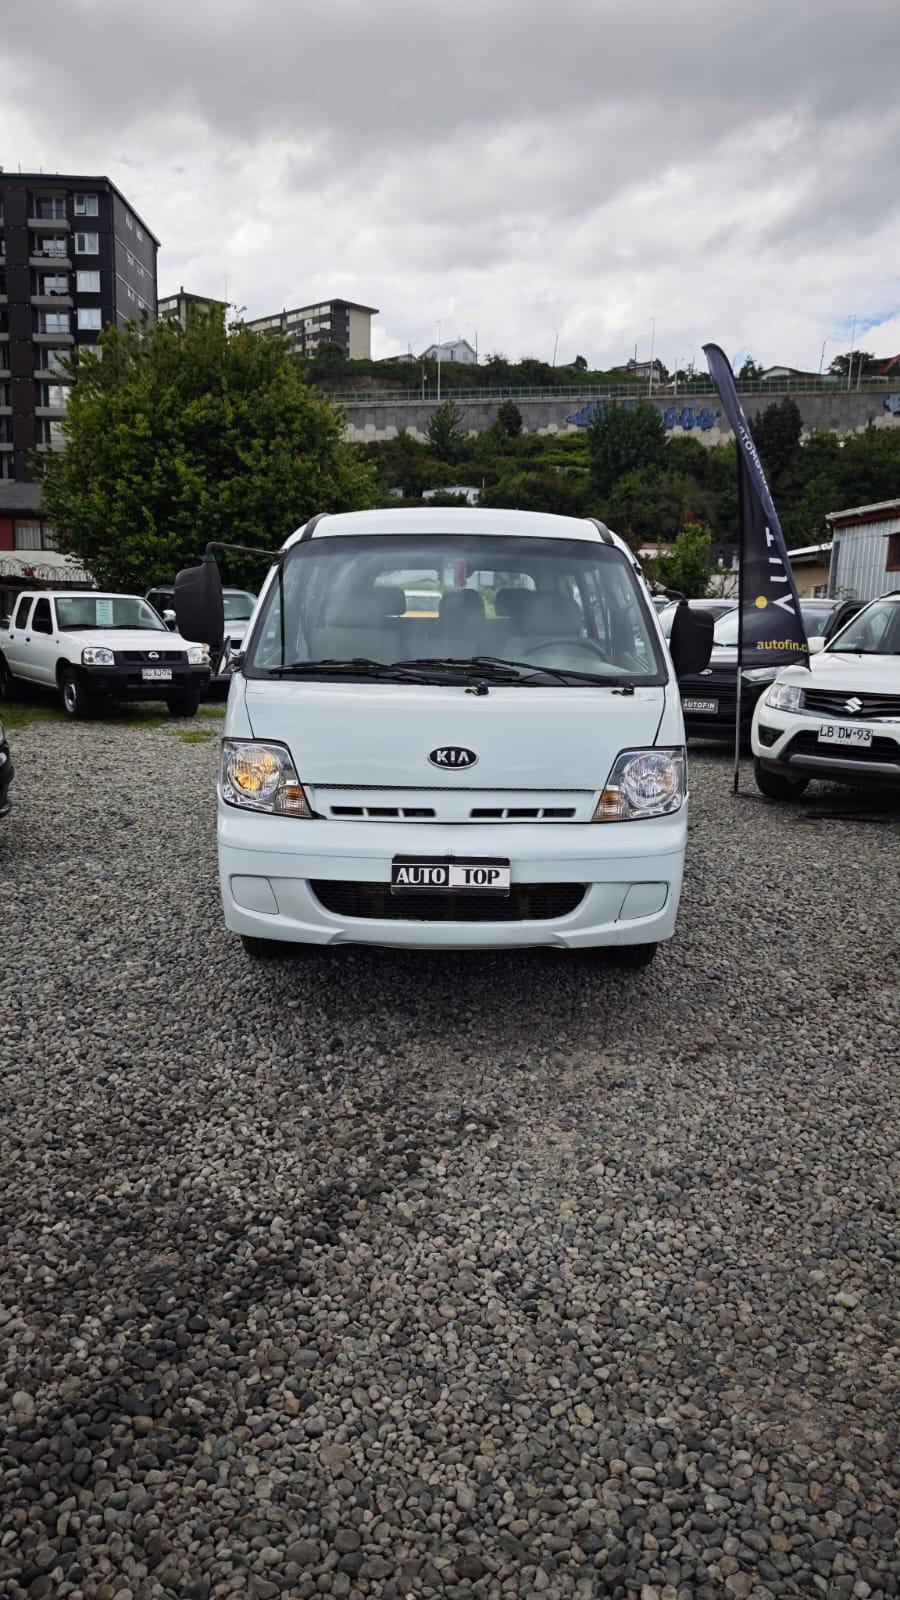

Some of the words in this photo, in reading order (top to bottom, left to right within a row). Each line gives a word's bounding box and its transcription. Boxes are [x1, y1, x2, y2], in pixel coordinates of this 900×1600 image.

[683, 701, 716, 709] AUTOFIN
[436, 750, 470, 764] KIA
[396, 867, 446, 884] AUTO
[461, 868, 500, 885] TOP
